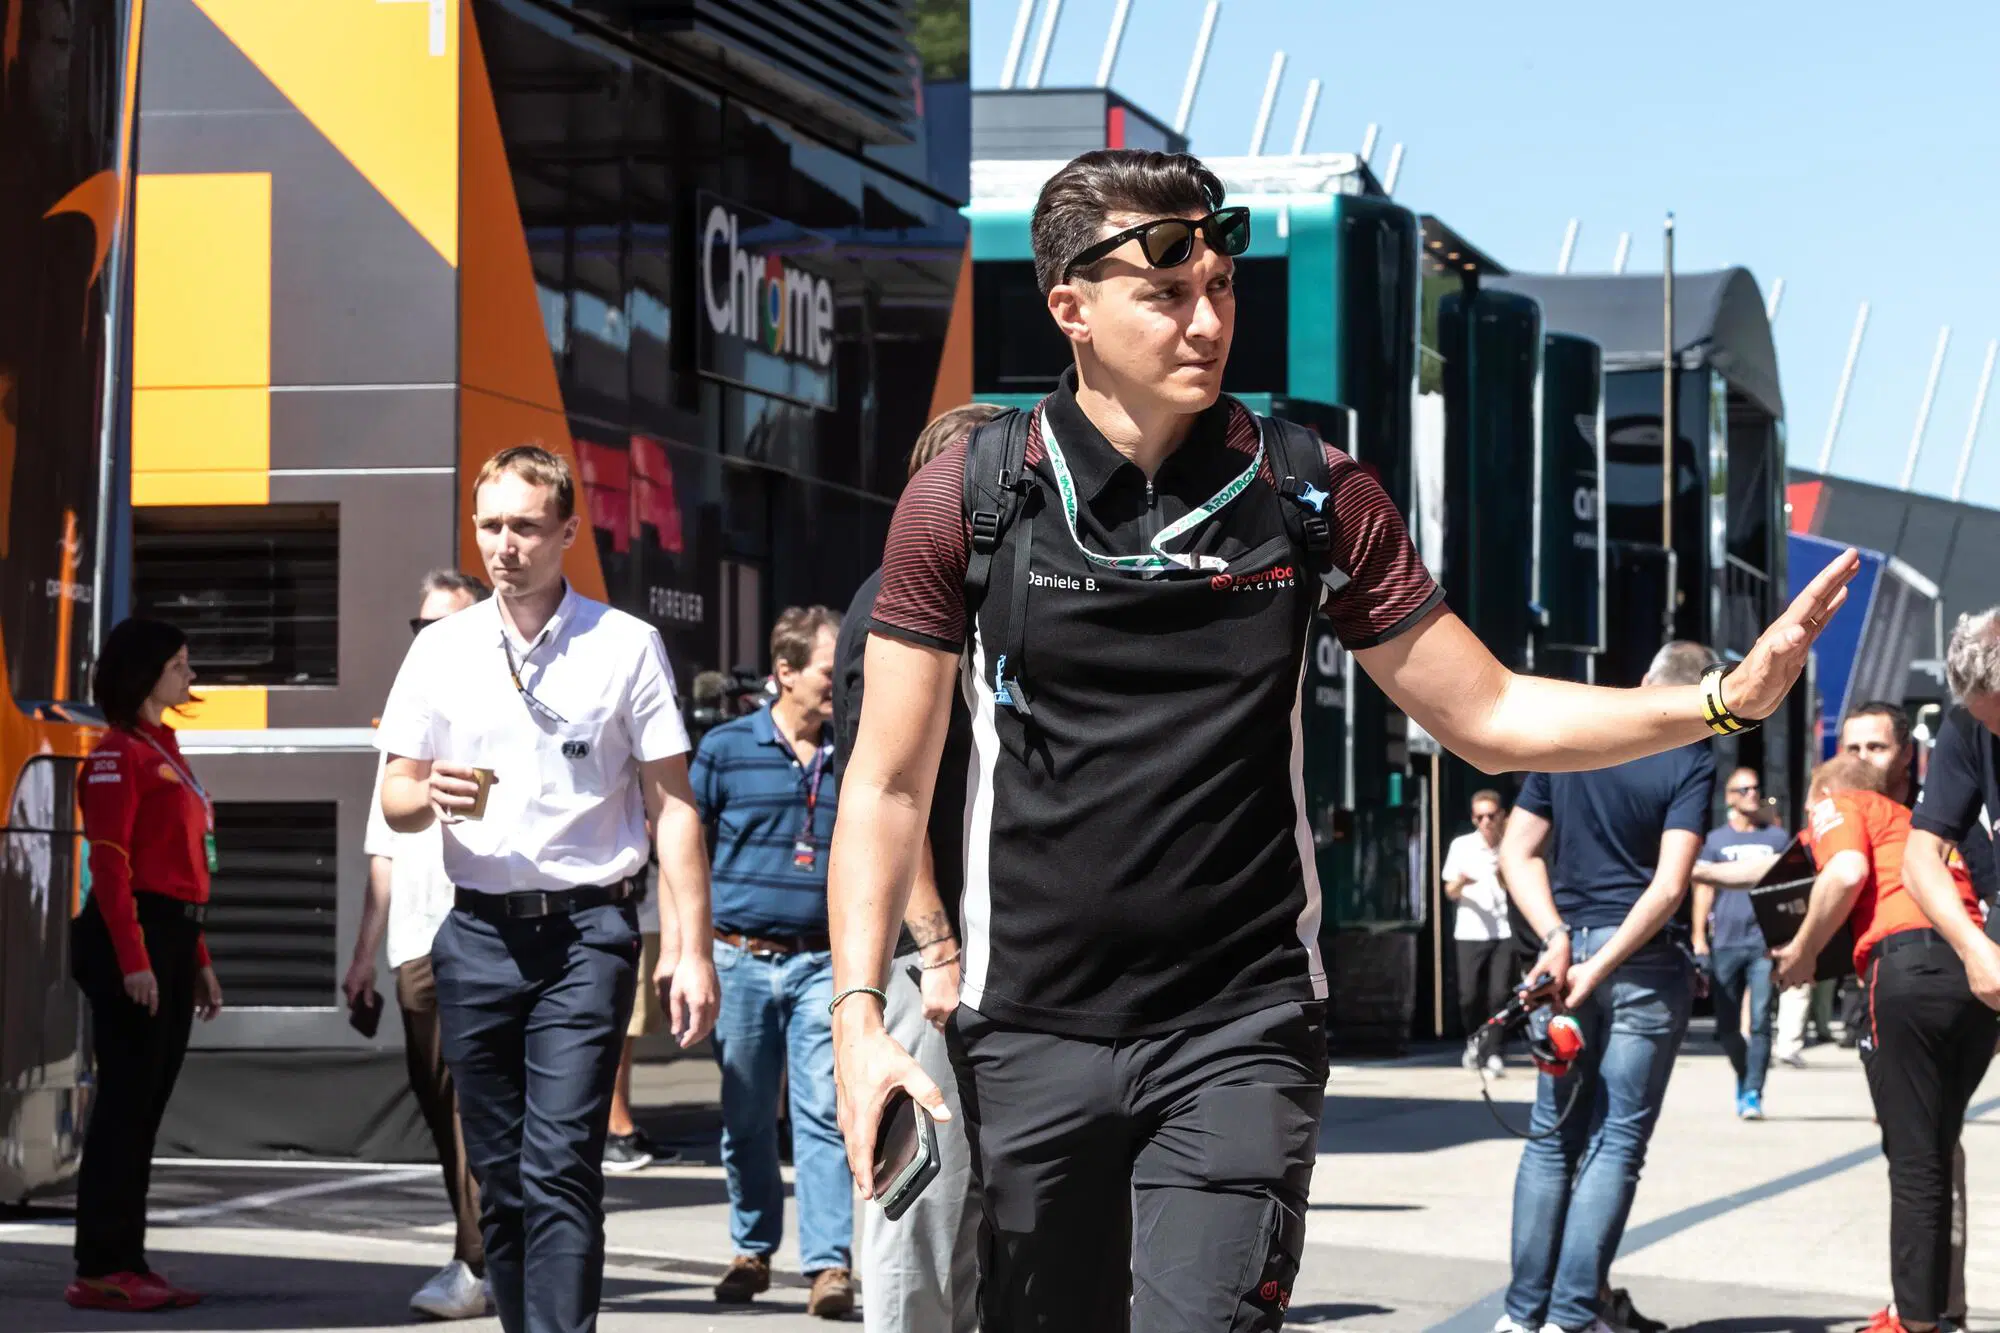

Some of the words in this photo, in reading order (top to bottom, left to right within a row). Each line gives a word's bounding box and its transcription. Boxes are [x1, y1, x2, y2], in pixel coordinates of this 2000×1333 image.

[702, 205, 834, 366] Chrome
[1085, 578, 1100, 592] B.
[1232, 579, 1295, 592] RACING
[650, 586, 703, 621] FOREVER
